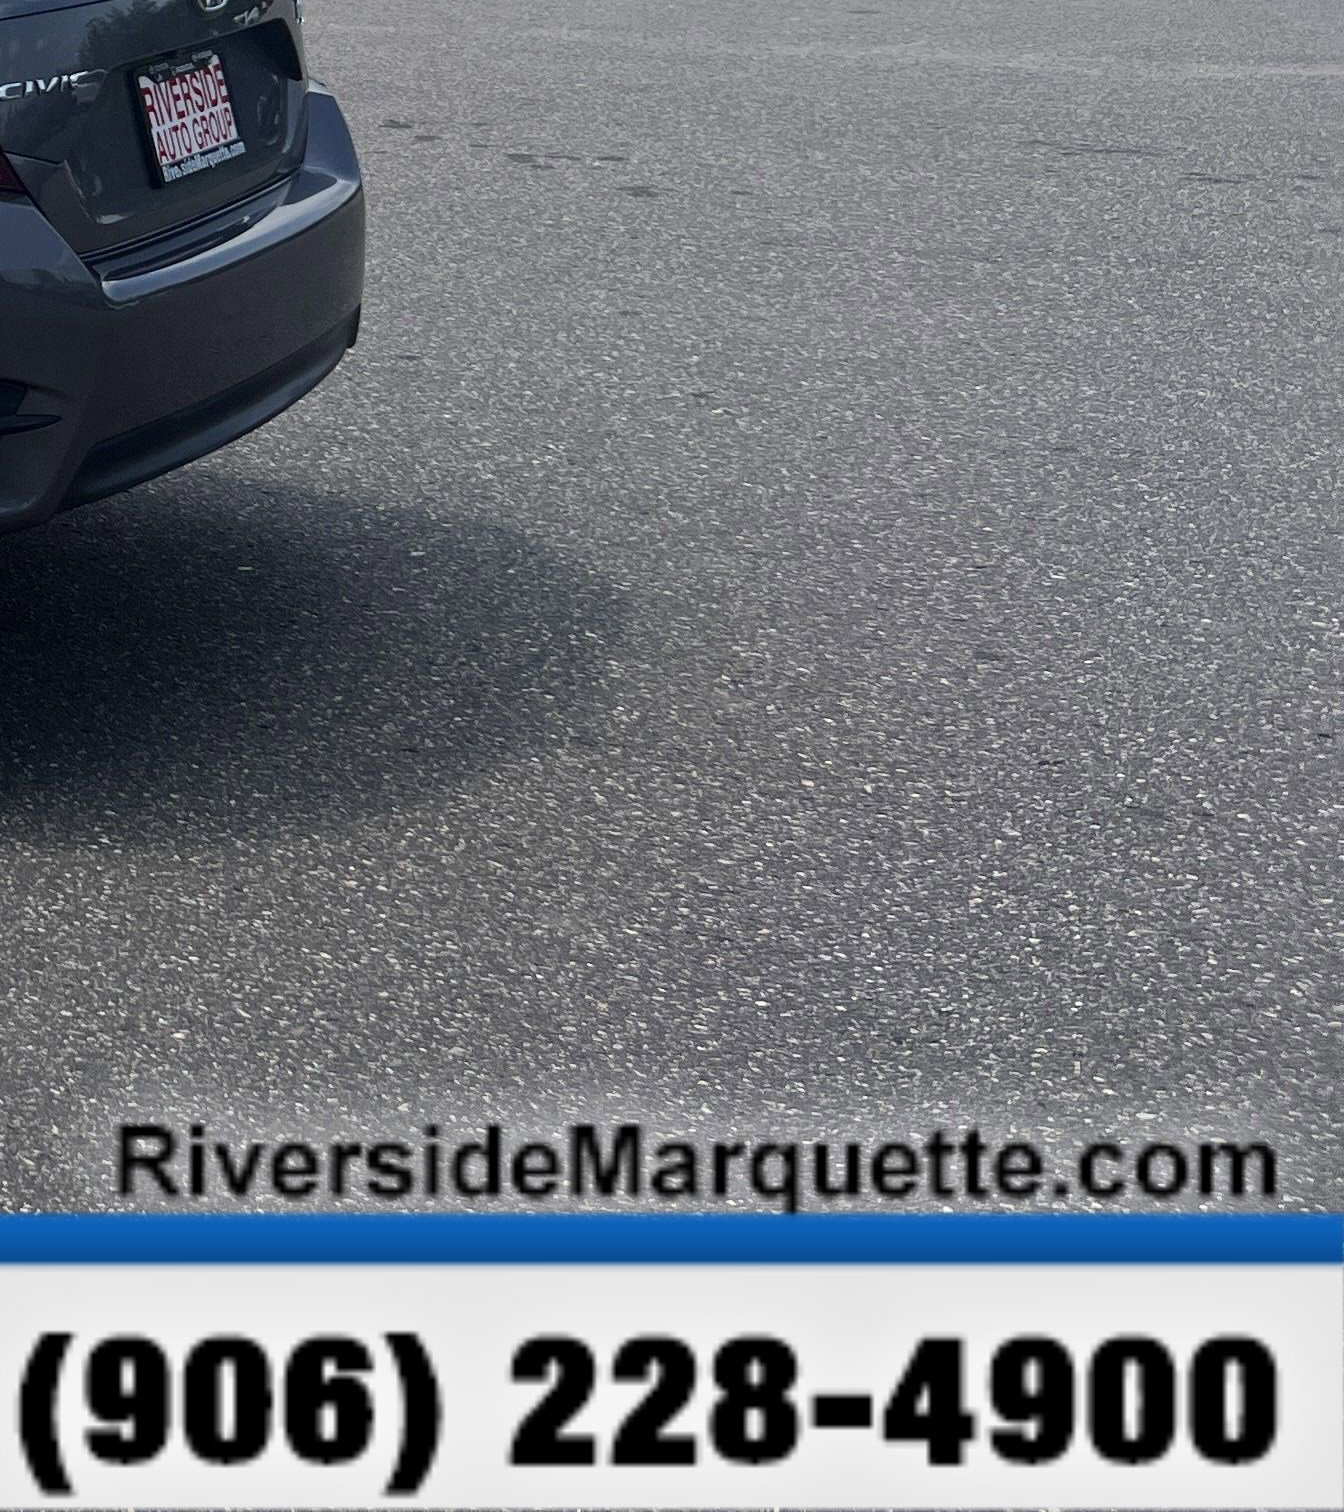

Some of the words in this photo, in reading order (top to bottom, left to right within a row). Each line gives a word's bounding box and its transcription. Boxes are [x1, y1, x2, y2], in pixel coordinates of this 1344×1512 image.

[139, 64, 230, 129] RIVERSIDE
[156, 121, 193, 164] AUTO
[192, 106, 234, 150] GROUP
